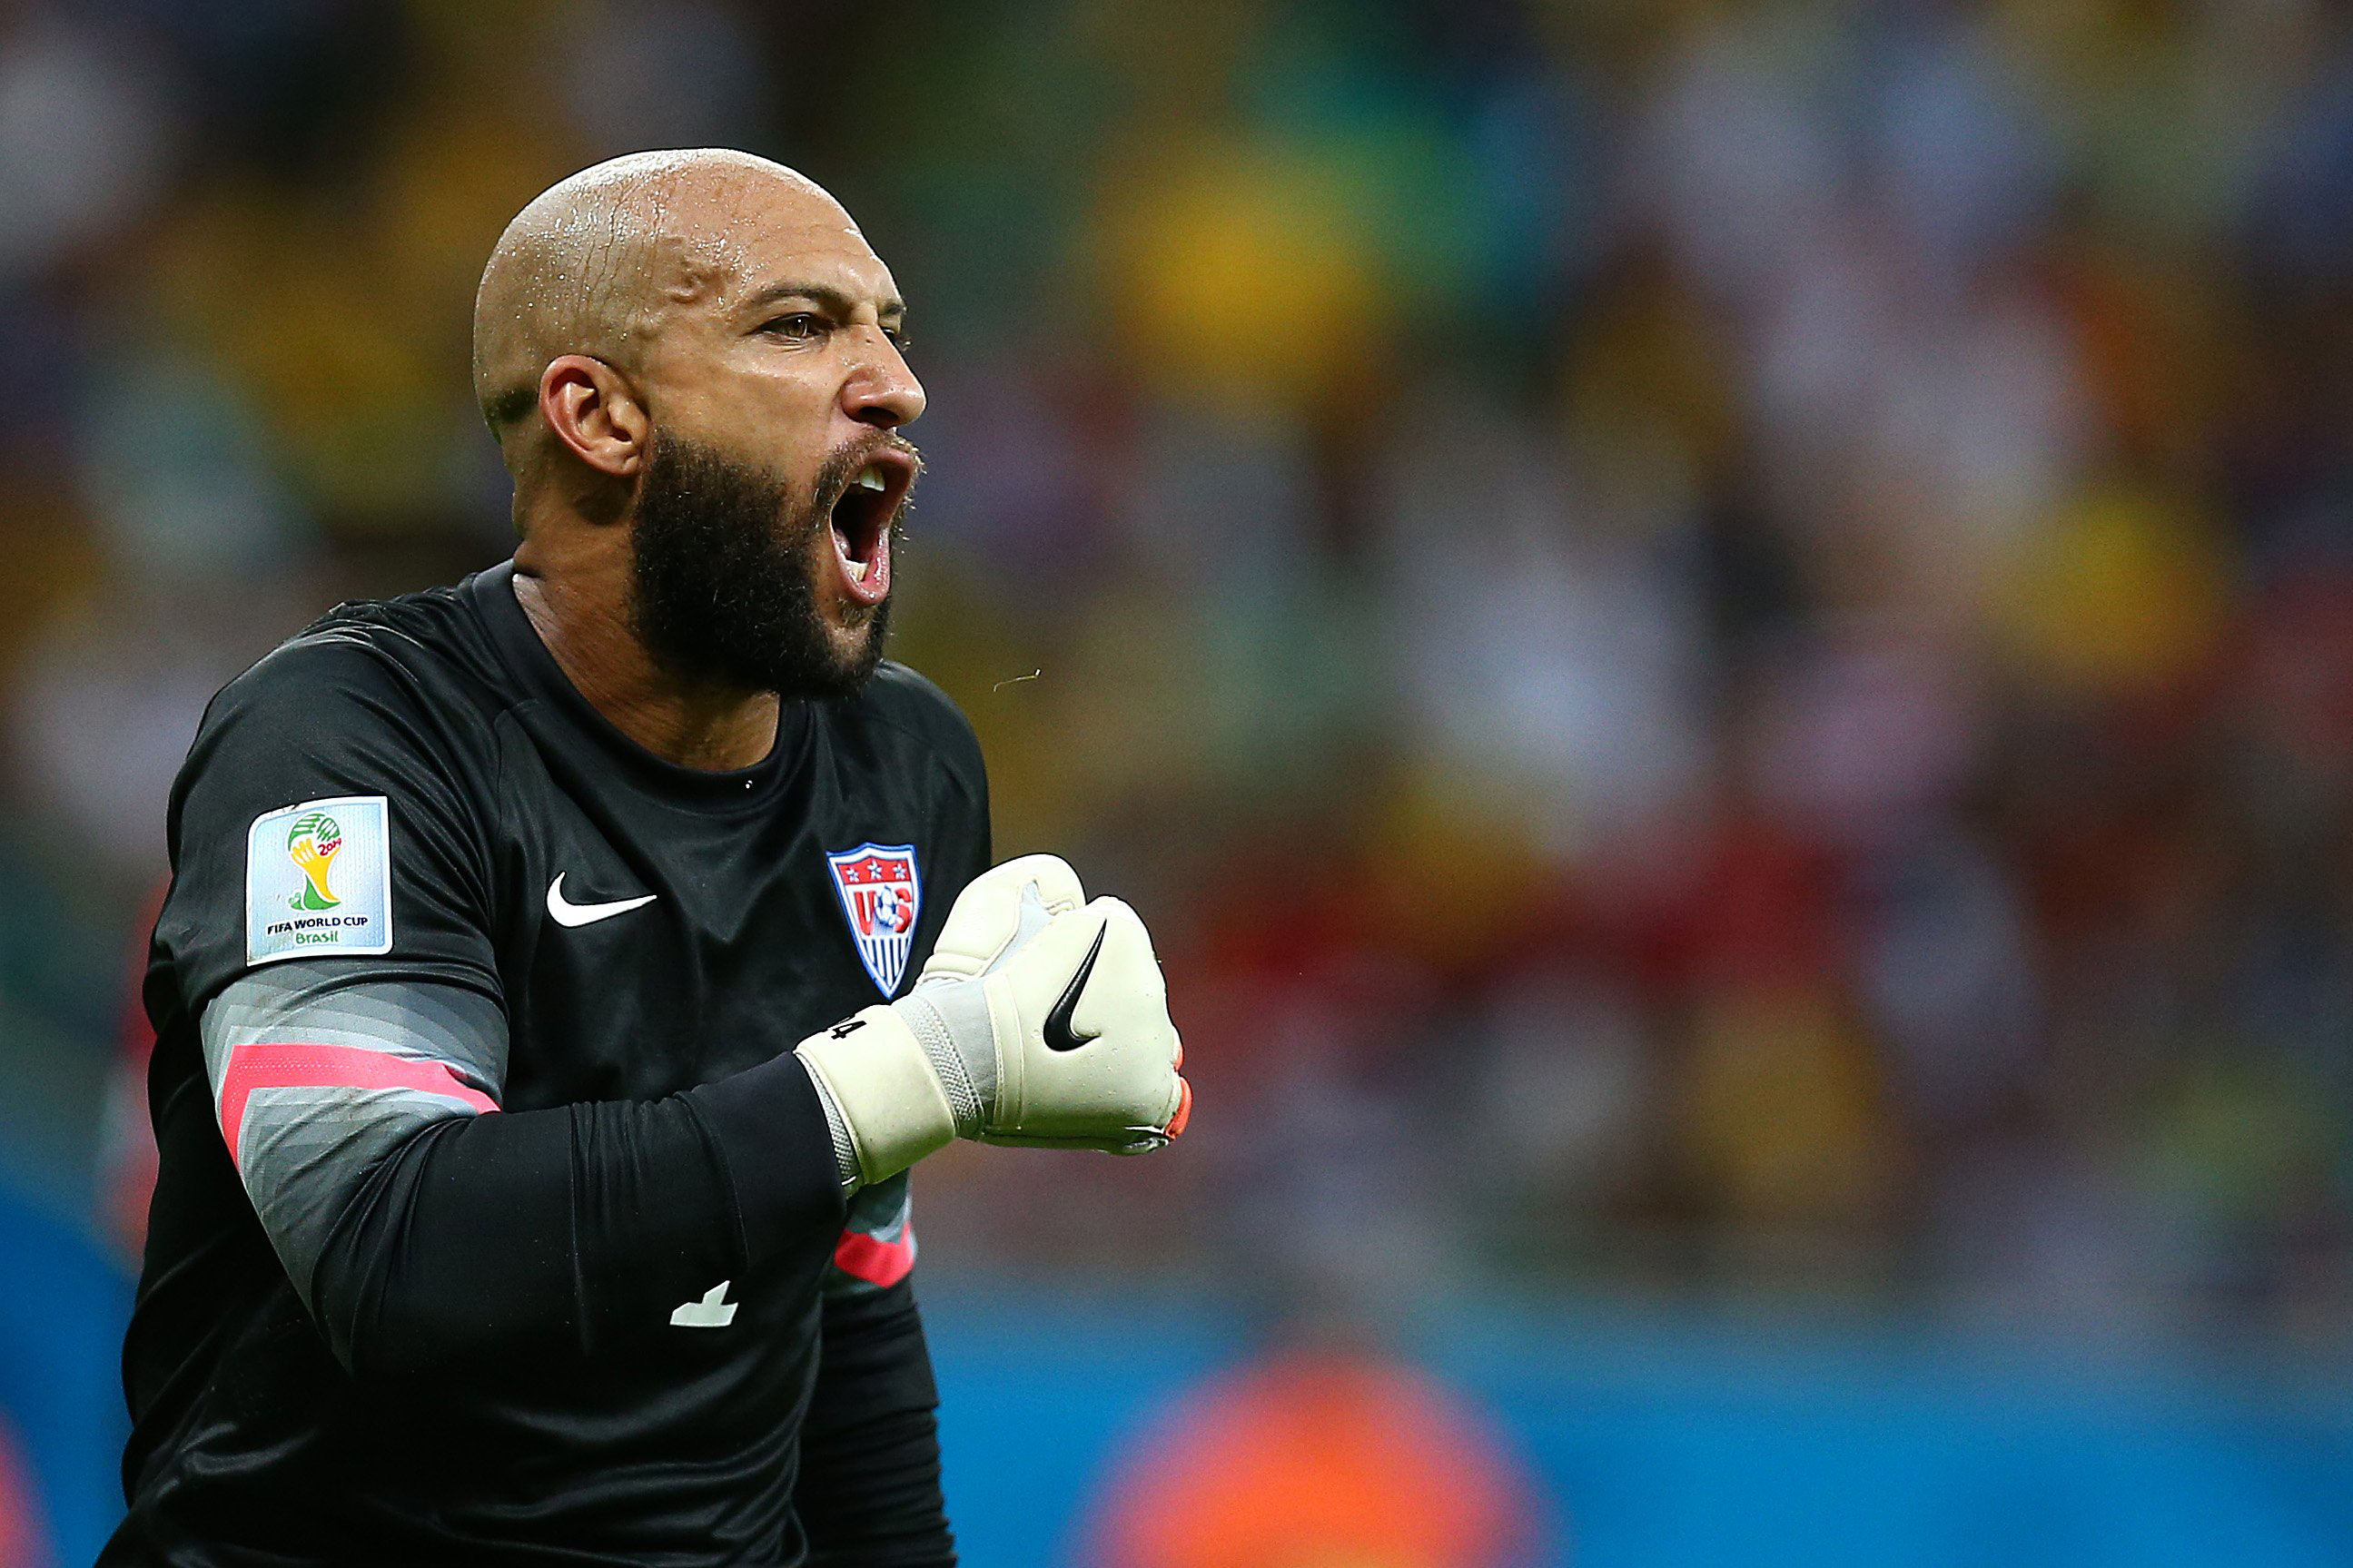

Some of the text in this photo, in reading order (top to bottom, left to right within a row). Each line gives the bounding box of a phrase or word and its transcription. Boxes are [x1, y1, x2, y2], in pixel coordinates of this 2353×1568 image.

[318, 837, 341, 856] 2014
[854, 887, 912, 936] US
[267, 916, 368, 935] FIFA WORLD CUP
[295, 931, 339, 944] Brasil
[831, 1016, 867, 1040] 4
